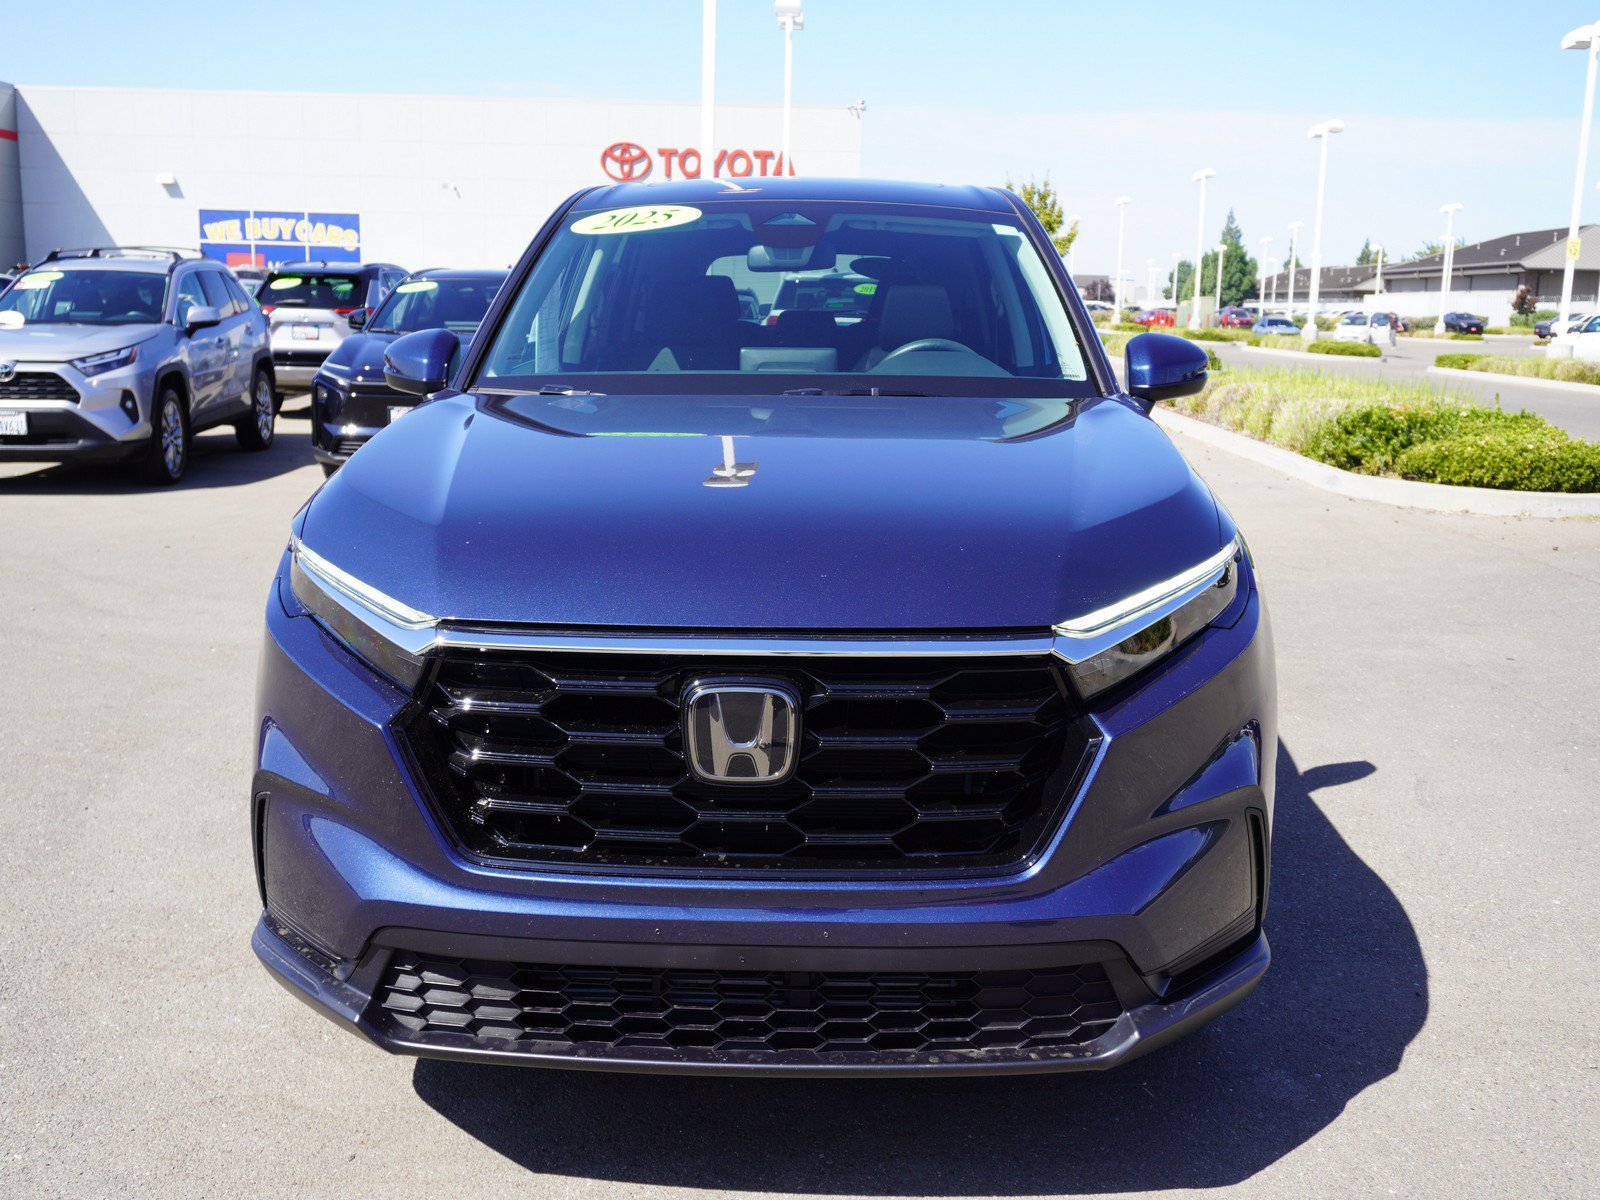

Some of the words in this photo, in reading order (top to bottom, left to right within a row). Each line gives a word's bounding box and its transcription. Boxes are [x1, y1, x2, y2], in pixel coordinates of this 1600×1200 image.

[591, 208, 681, 231] 2025
[203, 219, 243, 241] WE
[244, 217, 297, 241] BUY
[295, 219, 359, 252] CARS
